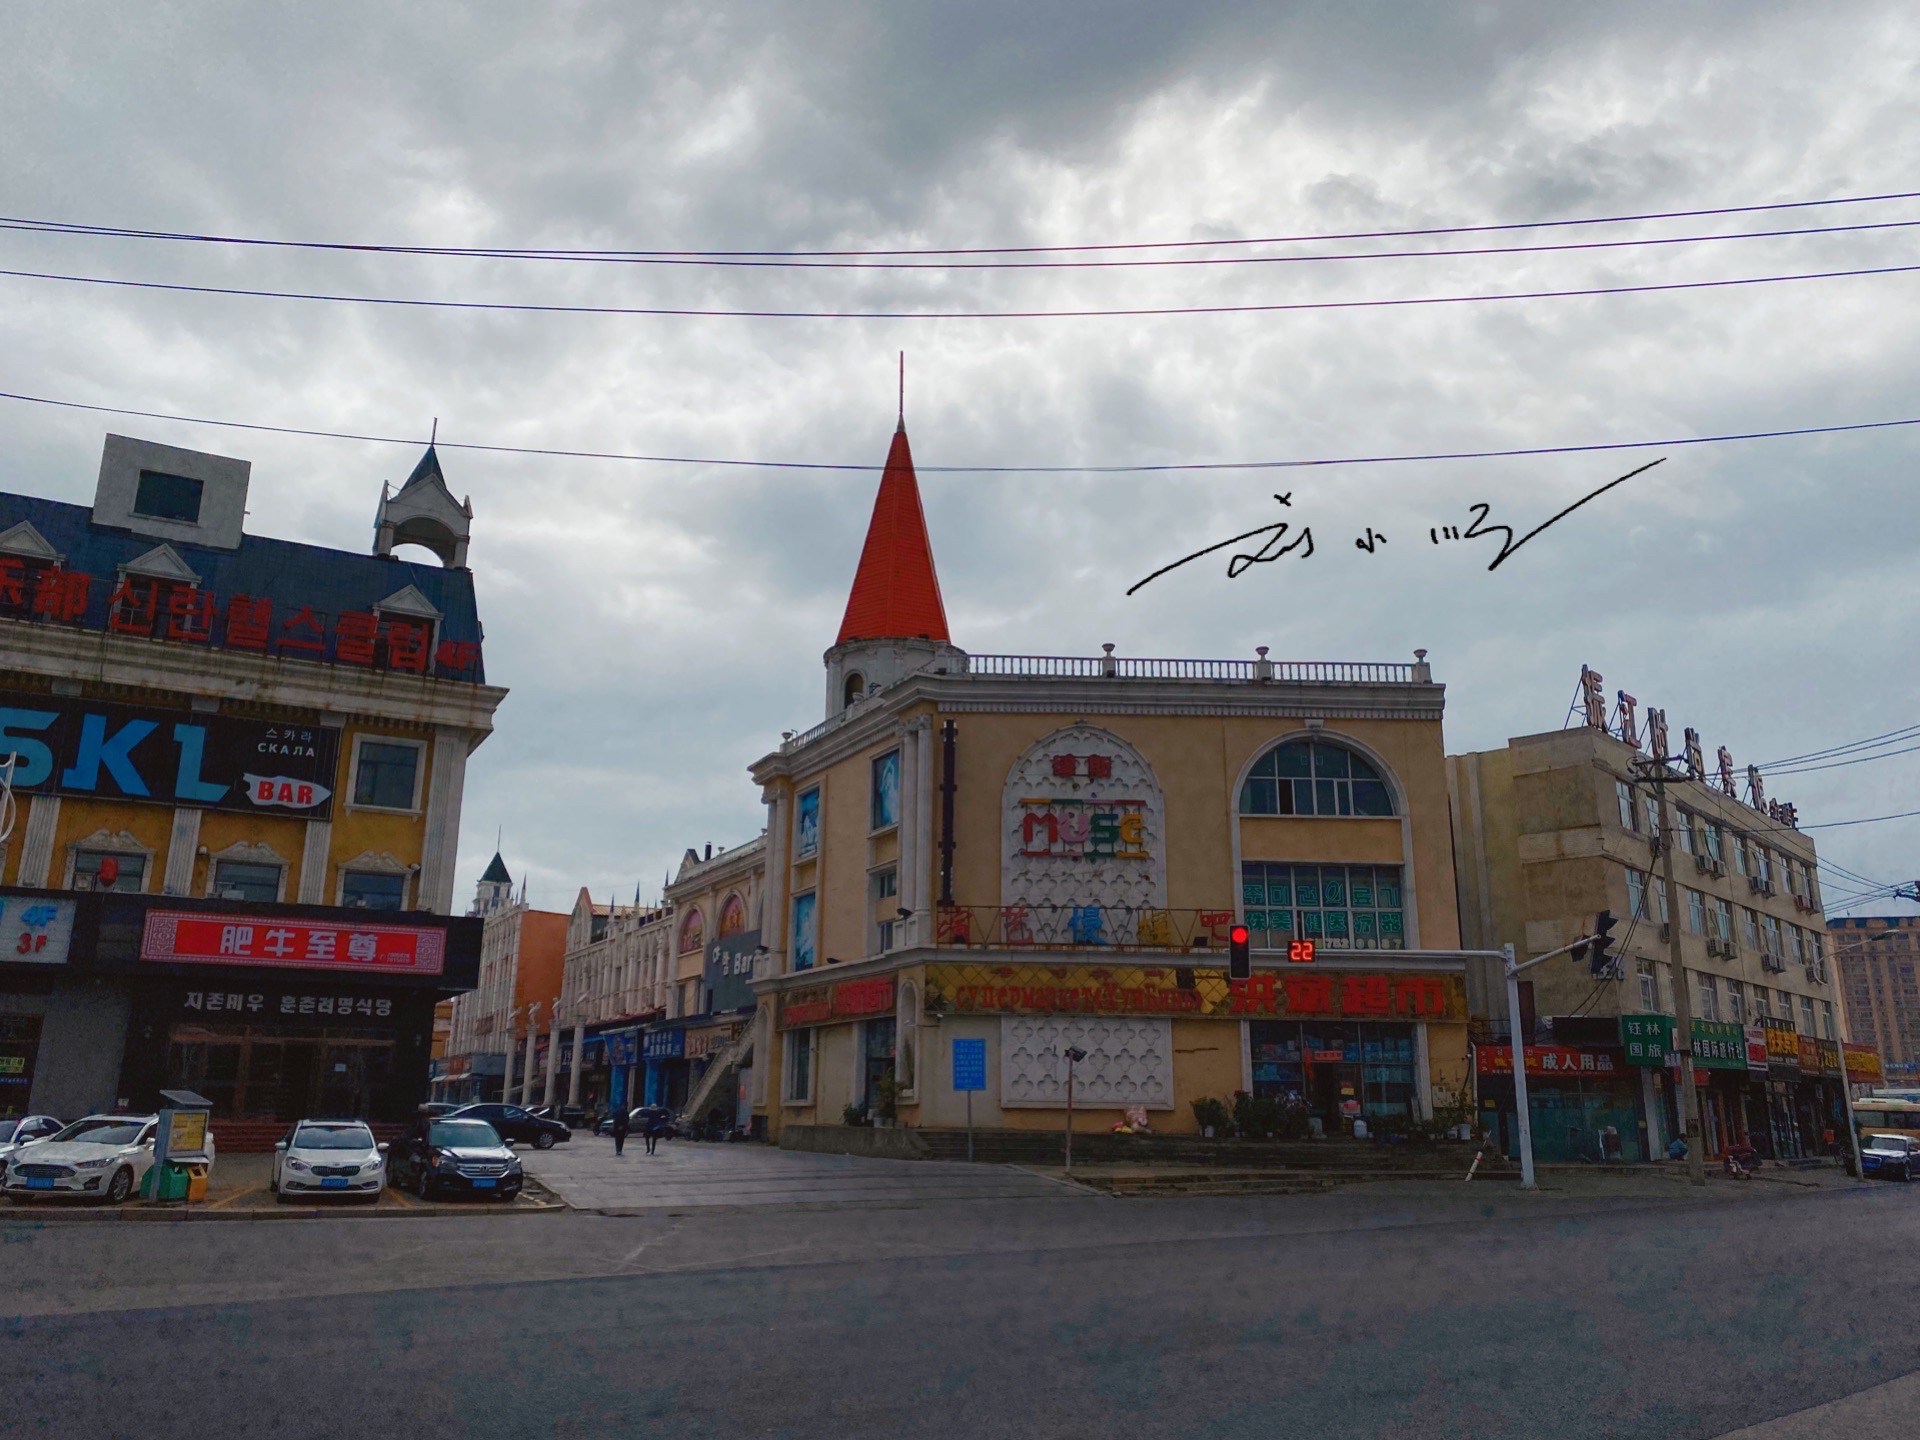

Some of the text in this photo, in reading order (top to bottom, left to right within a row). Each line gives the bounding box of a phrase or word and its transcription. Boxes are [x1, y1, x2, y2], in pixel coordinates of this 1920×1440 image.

[109, 577, 429, 671] 신라헬스클럽
[435, 640, 478, 670] 4F
[265, 727, 313, 743] 스카라
[258, 742, 315, 758] СКАЛА
[257, 780, 313, 805] BAR
[1023, 812, 1144, 845] MUSE
[20, 905, 58, 927] 4F
[219, 924, 379, 962] 肥牛至尊
[1291, 942, 1313, 960] 22
[1627, 1021, 1661, 1036] 钰林
[1629, 1042, 1662, 1058] 国旅
[1689, 1038, 1744, 1060] 林国际旅行社
[1541, 1052, 1614, 1071] 成人用品
